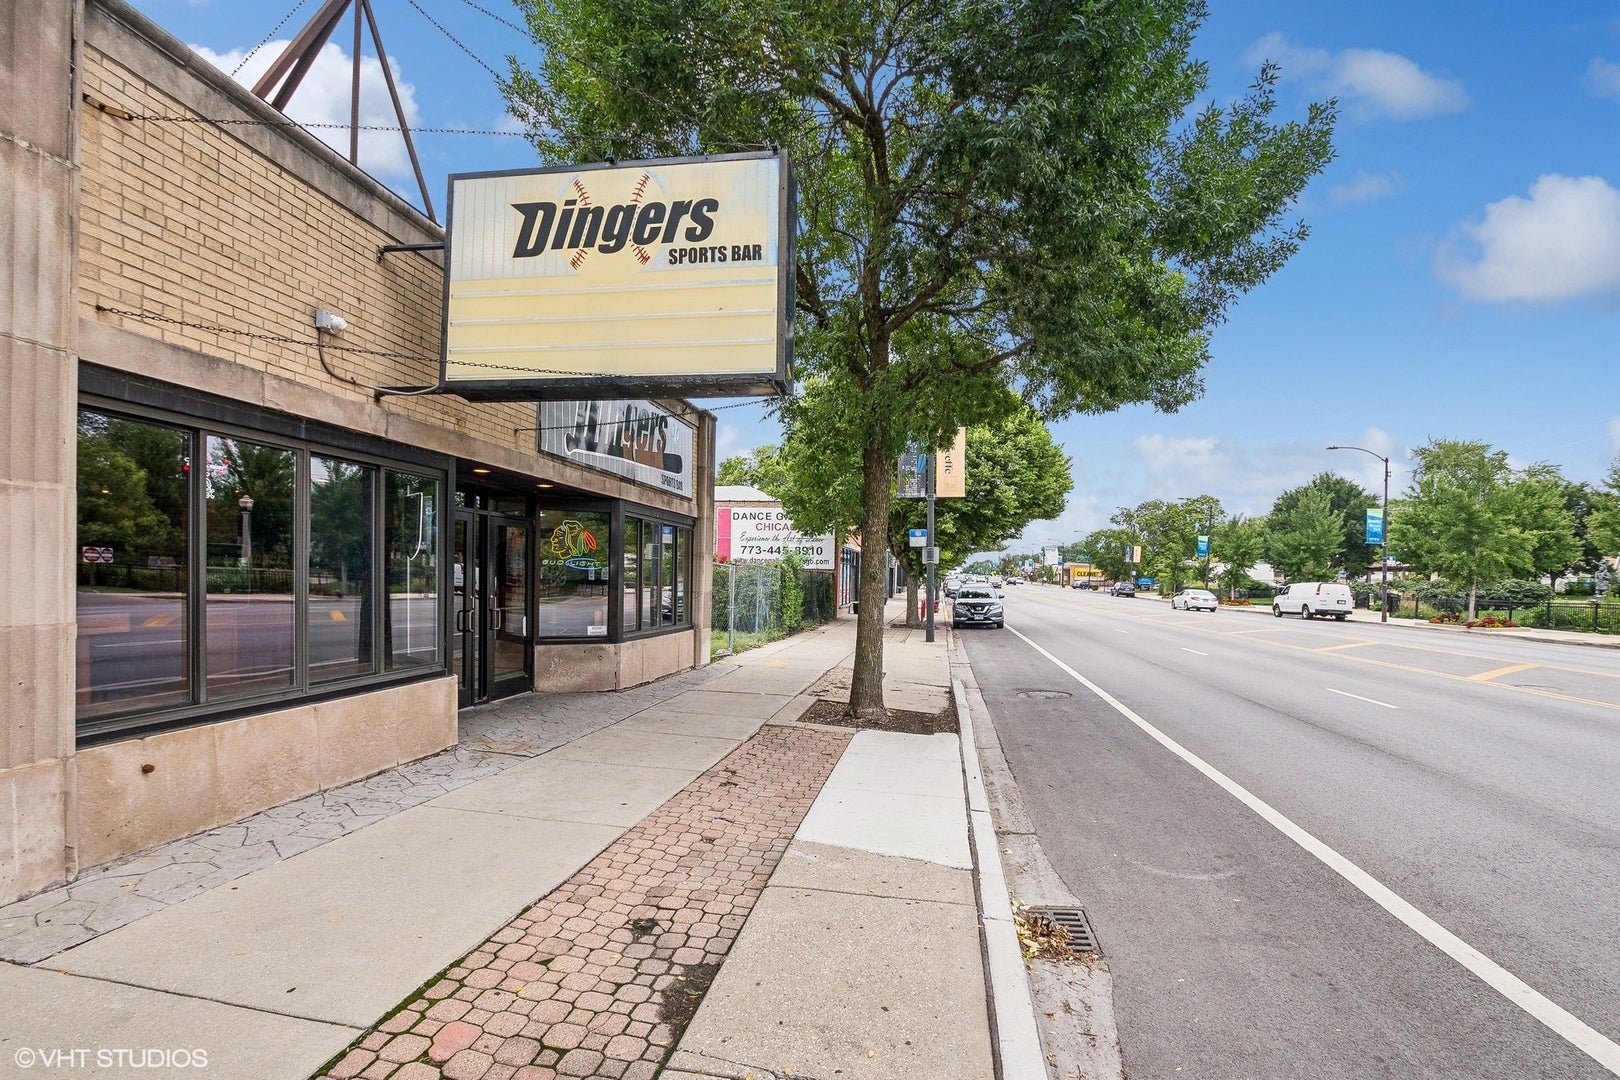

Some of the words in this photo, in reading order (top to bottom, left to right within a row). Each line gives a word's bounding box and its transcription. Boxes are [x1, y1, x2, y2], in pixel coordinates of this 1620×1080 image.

[511, 198, 719, 259] Dingers
[668, 245, 728, 265] SPORTS
[731, 244, 762, 262] BAR
[732, 512, 772, 521] DANCE
[755, 522, 797, 531] CHICA
[739, 531, 770, 545] Experience
[771, 533, 781, 541] the
[782, 532, 795, 542] Art
